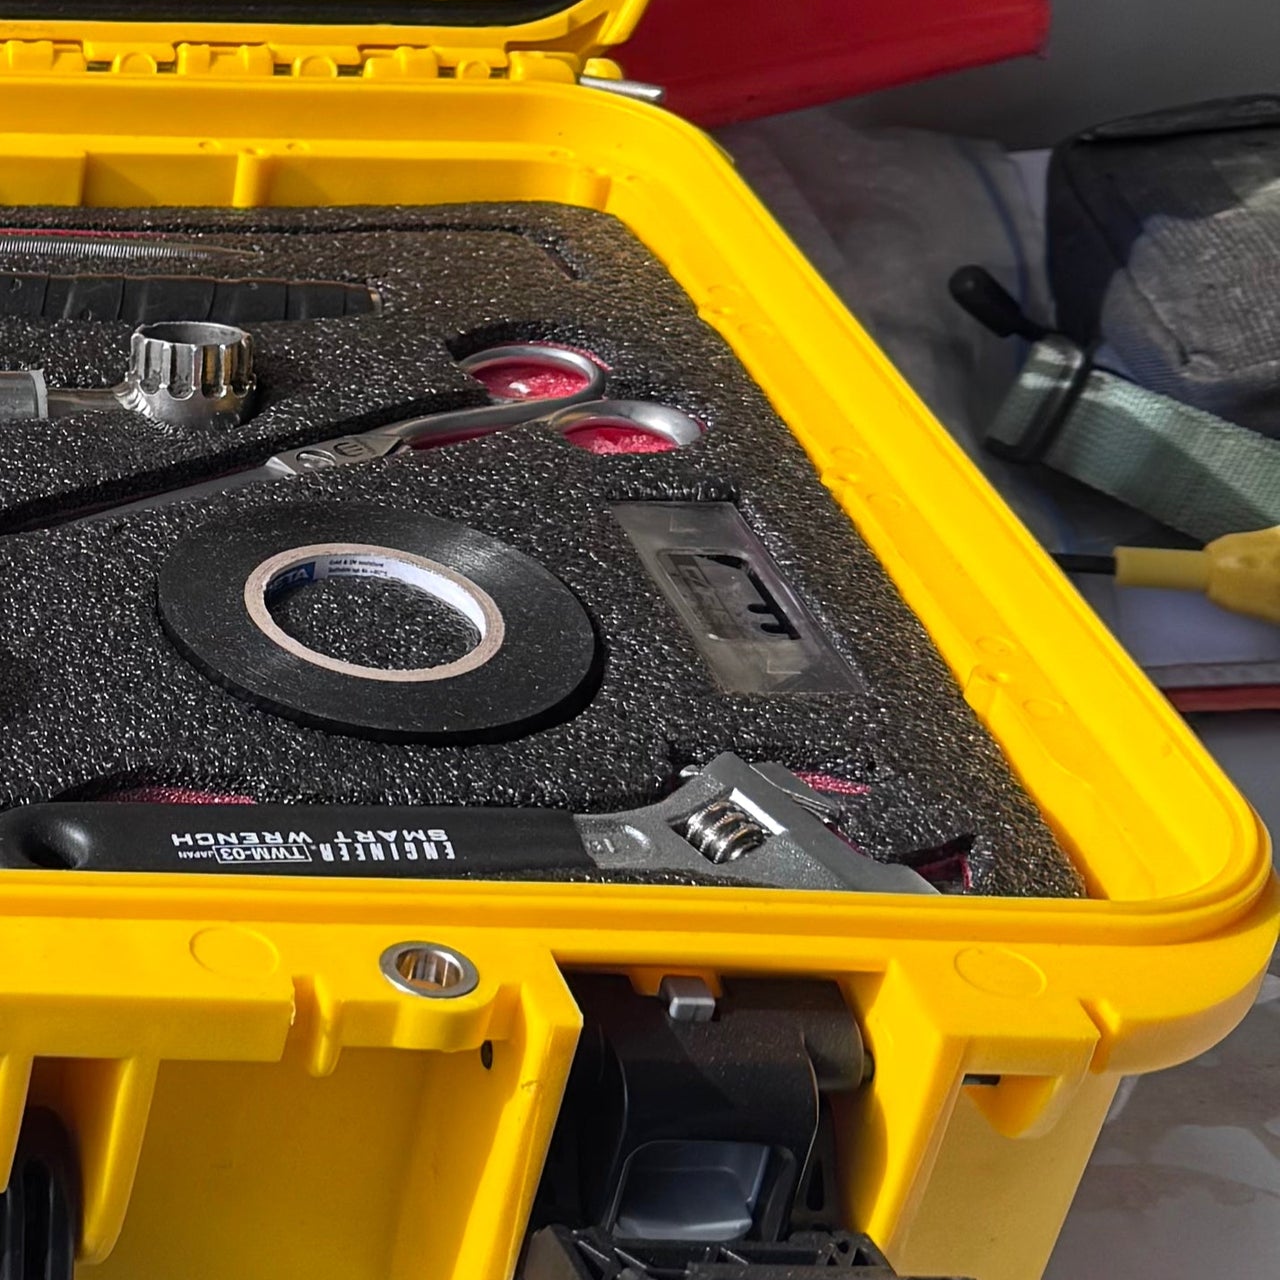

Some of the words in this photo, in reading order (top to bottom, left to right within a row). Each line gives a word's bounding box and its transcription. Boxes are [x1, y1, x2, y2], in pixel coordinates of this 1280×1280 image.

[171, 831, 313, 846] WRENCH
[334, 829, 448, 843] SMART
[178, 850, 214, 860] JAPAN
[221, 845, 305, 861] TWM-03
[320, 841, 455, 862] ENGINEER
